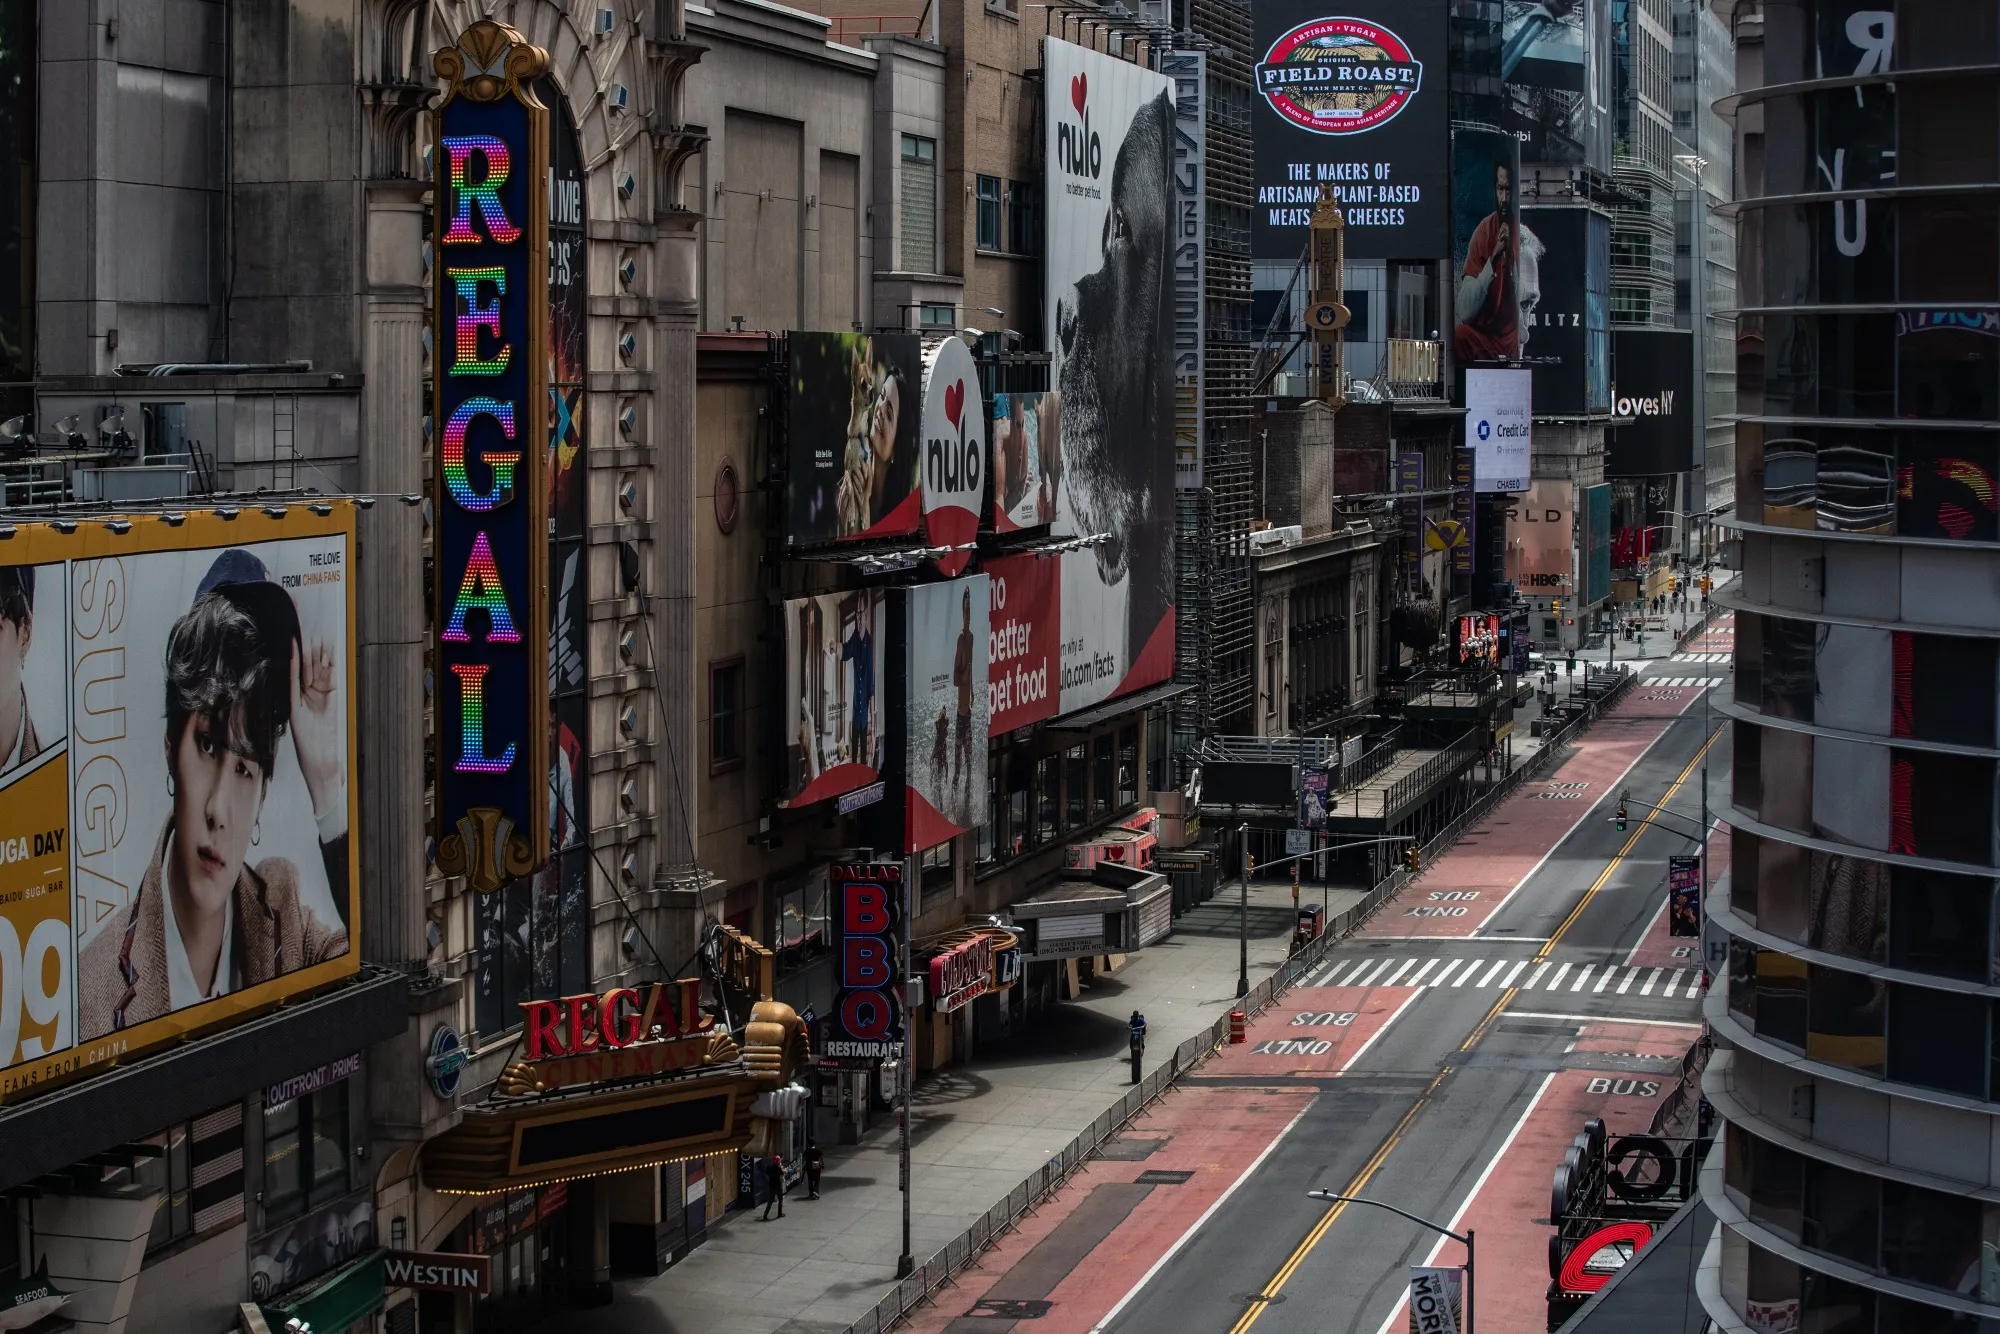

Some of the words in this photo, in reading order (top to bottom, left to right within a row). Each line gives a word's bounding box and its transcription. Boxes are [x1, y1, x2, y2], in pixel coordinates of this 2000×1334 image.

[1293, 25, 1333, 45] ARTISAN
[1344, 25, 1377, 39] VEGAN
[1264, 67, 1332, 84] FIELD
[1163, 56, 1198, 121] NEW
[1286, 105, 1302, 119] BLEND
[1311, 118, 1342, 127] EUROPEAN
[1356, 115, 1374, 125] ASIAN
[1374, 99, 1398, 120] HERITAGE
[1058, 106, 1101, 179] nulo
[1288, 163, 1311, 180] THE
[1317, 163, 1368, 180] MAKERS
[1375, 163, 1391, 180] OF
[1072, 184, 1083, 198] better
[1259, 186, 1326, 203] ARTISANA
[1334, 185, 1420, 203] PLANT-BASED
[1269, 208, 1310, 226] MEATS
[1348, 208, 1405, 225] CHEESES
[1321, 236, 1332, 292] THEATRE
[1321, 343, 1332, 385] LYRIC
[1611, 390, 1659, 416] loves
[1661, 390, 1674, 415] NY
[1497, 424, 1519, 437] Credit
[441, 134, 523, 775] REGAL
[928, 415, 979, 493] nulo
[1497, 481, 1515, 489] CHASE
[309, 554, 322, 567] THE
[324, 552, 341, 565] LOVE
[282, 575, 301, 588] FROM
[303, 571, 322, 586] CHINA
[324, 570, 341, 583] FANS
[1530, 574, 1560, 586] HBO
[989, 577, 1006, 611] no
[989, 618, 1031, 665] better
[1067, 638, 1078, 656] why
[1078, 638, 1084, 651] at
[989, 670, 1012, 725] pet
[1016, 656, 1047, 707] food
[73, 555, 129, 940] SUGA
[1549, 782, 1590, 790] BUS
[34, 828, 64, 857] DAY
[830, 866, 900, 882] DALLAS
[0, 891, 23, 905] BAIDU
[26, 885, 46, 898] SUGA
[49, 881, 63, 893] BAR
[1428, 891, 1480, 901] BUS
[1404, 906, 1469, 917] ONLY
[841, 882, 893, 1042] BBQ
[518, 978, 713, 1061] REGAL
[1291, 1012, 1359, 1026] BUS
[828, 1041, 904, 1057] RESTAURANT
[1249, 1040, 1334, 1055] ONLY
[5, 1069, 37, 1094] FANS
[46, 1056, 81, 1081] FROM
[89, 1040, 128, 1064] CHINA
[544, 1043, 697, 1085] CINEMAS
[270, 1066, 326, 1103] OUTFRONT
[333, 1053, 359, 1079] PRIME
[1586, 1077, 1660, 1097] BUS
[741, 1173, 751, 1192] 245
[384, 1255, 480, 1287] WESTIN
[1431, 1273, 1442, 1294] THE
[15, 1287, 48, 1304] SEAFOOD
[1412, 1276, 1443, 1334] MOR
[1436, 1298, 1450, 1328] BOOK
